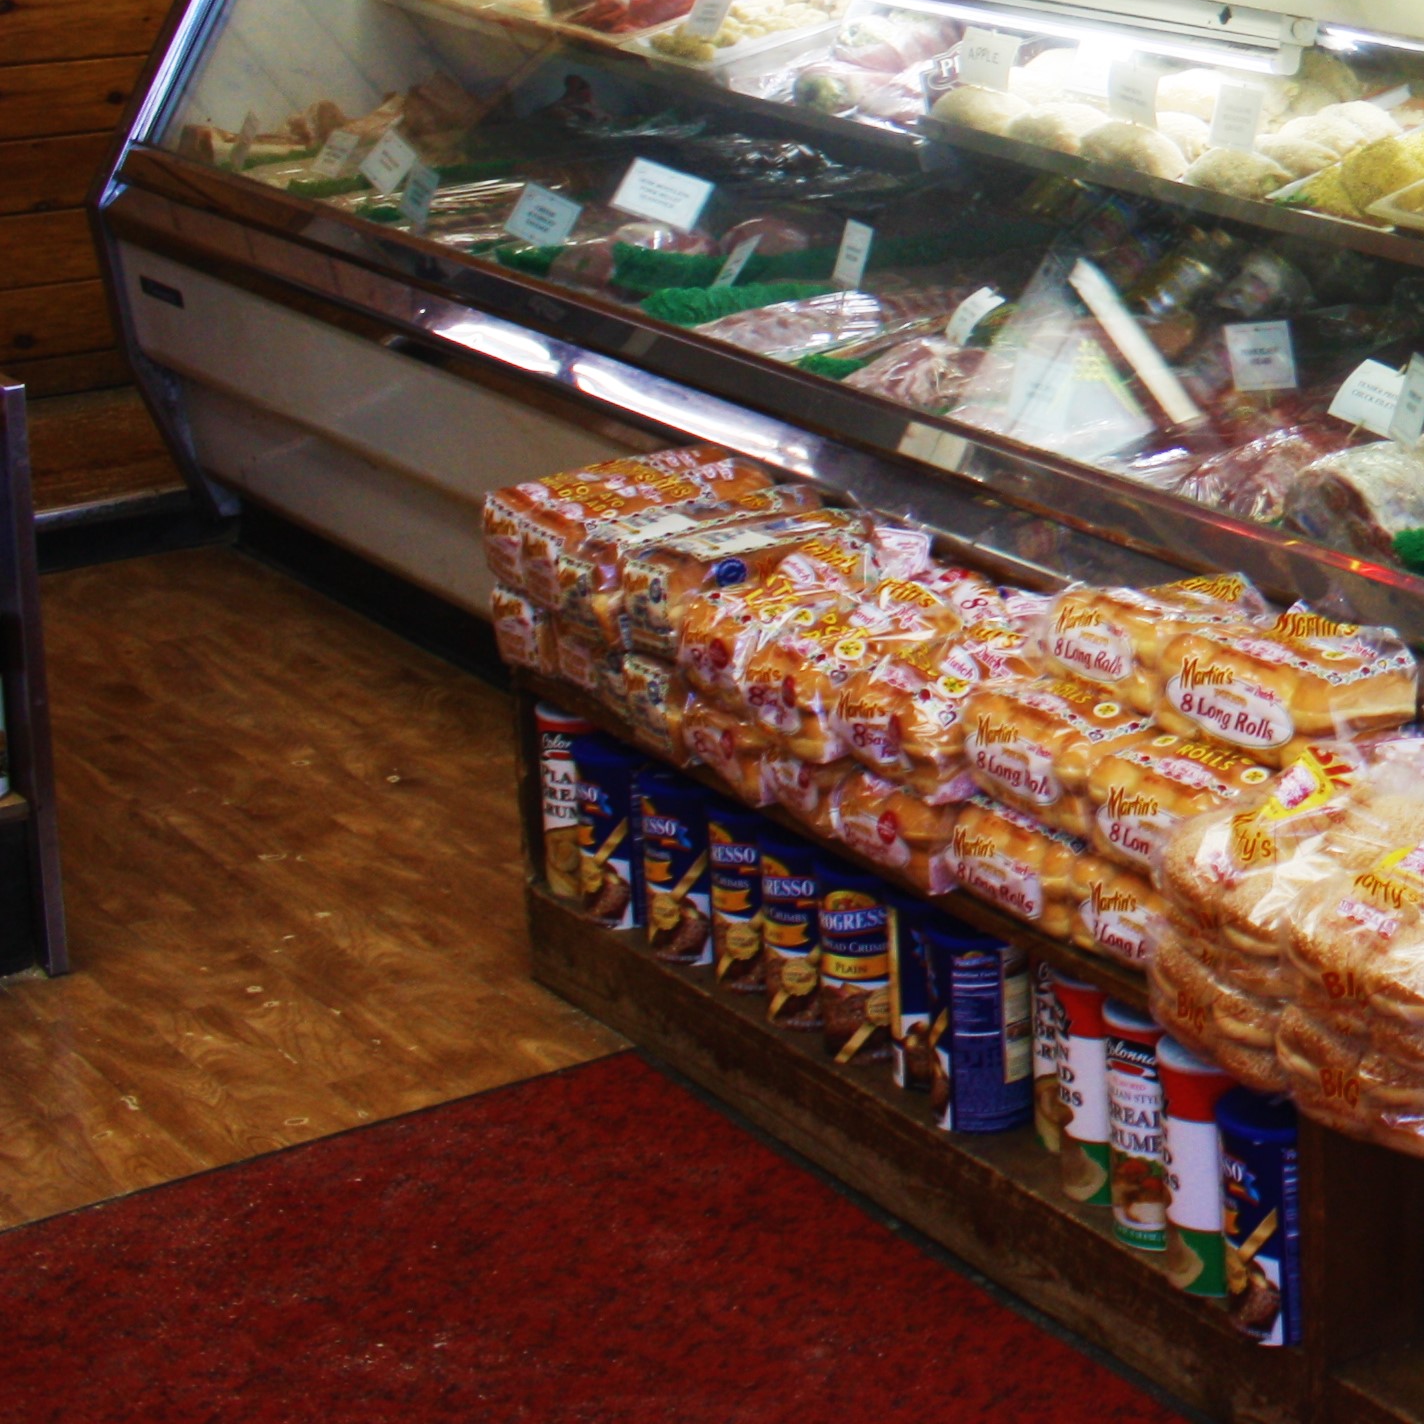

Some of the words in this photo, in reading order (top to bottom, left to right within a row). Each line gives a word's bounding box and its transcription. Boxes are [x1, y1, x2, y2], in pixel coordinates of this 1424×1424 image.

[1056, 605, 1100, 633] Martin's
[1053, 638, 1064, 657] 8
[1064, 639, 1092, 670] Long
[1096, 649, 1123, 676] Rolls
[1180, 656, 1234, 690] Martin's
[838, 688, 887, 722] Martin's
[1180, 693, 1193, 713] 8
[1196, 696, 1232, 731] Long
[1235, 712, 1275, 742] Rolls
[851, 722, 868, 748] 8
[975, 712, 1018, 746] Martin's
[976, 751, 986, 769] 8
[987, 752, 1021, 787] Long
[1176, 743, 1236, 772] ROLLS
[1107, 785, 1159, 821] Martin's
[953, 825, 996, 859] Martin's
[1108, 822, 1120, 843] 8
[1122, 827, 1150, 855] Lon
[956, 861, 966, 882] 8
[967, 867, 996, 900] Long
[999, 885, 1034, 914] Rolls
[1089, 880, 1137, 915] Martin's
[1099, 928, 1133, 958] Long
[834, 961, 868, 974] PLAIN
[1319, 1067, 1360, 1108] BIG
